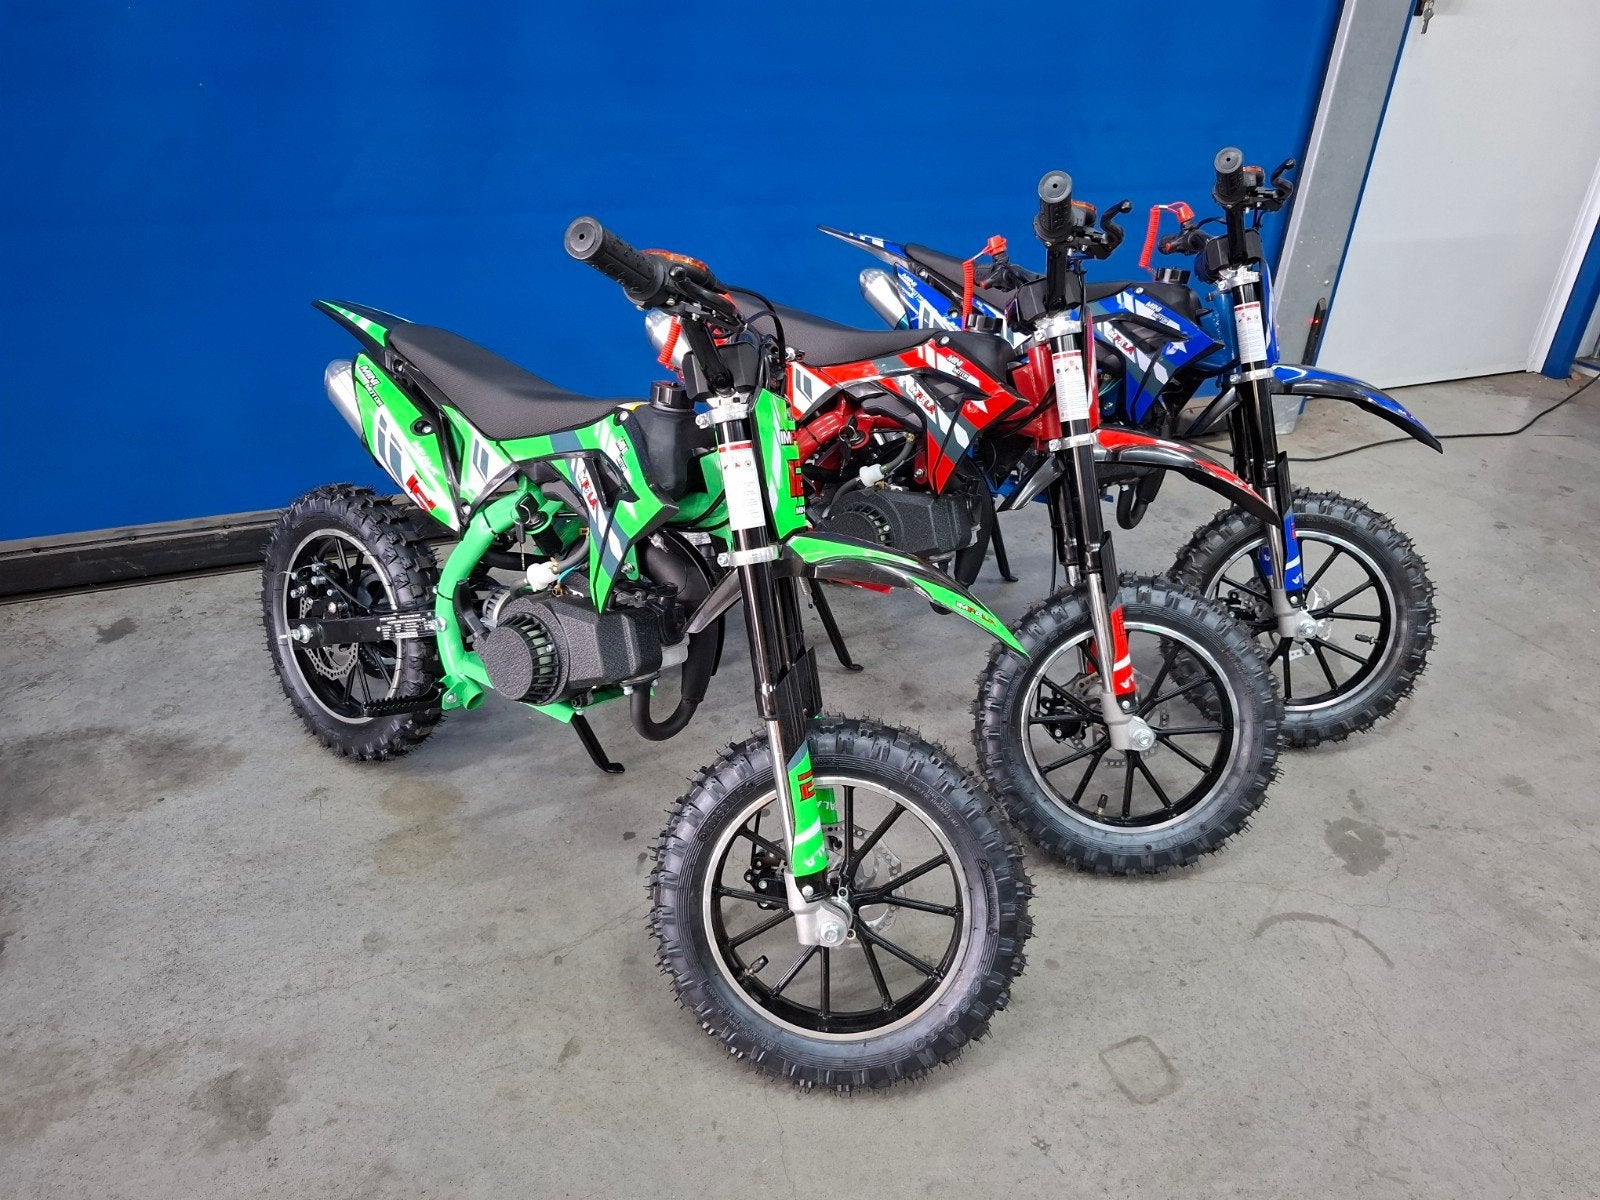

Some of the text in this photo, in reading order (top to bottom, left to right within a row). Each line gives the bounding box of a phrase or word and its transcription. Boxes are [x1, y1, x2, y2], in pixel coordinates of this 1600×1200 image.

[1144, 301, 1163, 313] MINI
[946, 354, 964, 367] MINI
[359, 365, 381, 387] MINI
[364, 383, 384, 407] MOTOR
[956, 600, 997, 627] IMPALA
